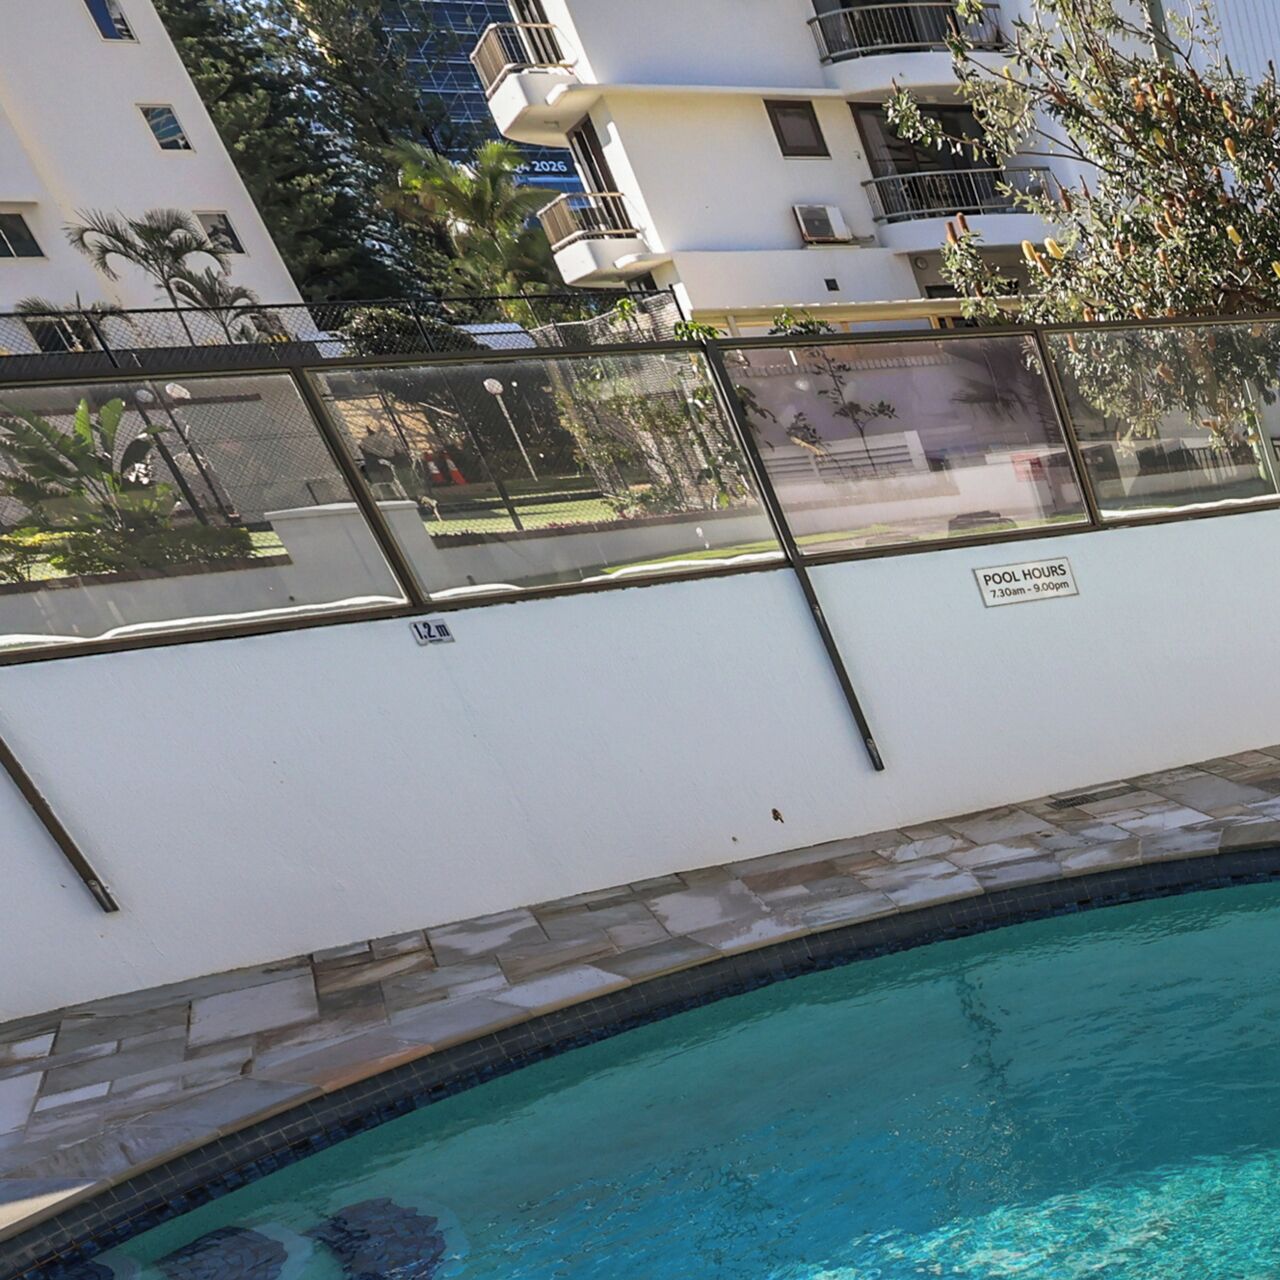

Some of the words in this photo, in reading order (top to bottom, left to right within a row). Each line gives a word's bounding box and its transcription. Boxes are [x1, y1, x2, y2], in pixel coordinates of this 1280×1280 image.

[532, 160, 568, 173] 2026
[983, 571, 1021, 586] POOL
[1021, 564, 1067, 581] HOURS
[989, 587, 1026, 599] 7.30am
[1033, 581, 1070, 593] 9.00pm
[413, 622, 436, 640] 1.2
[435, 624, 451, 638] m
